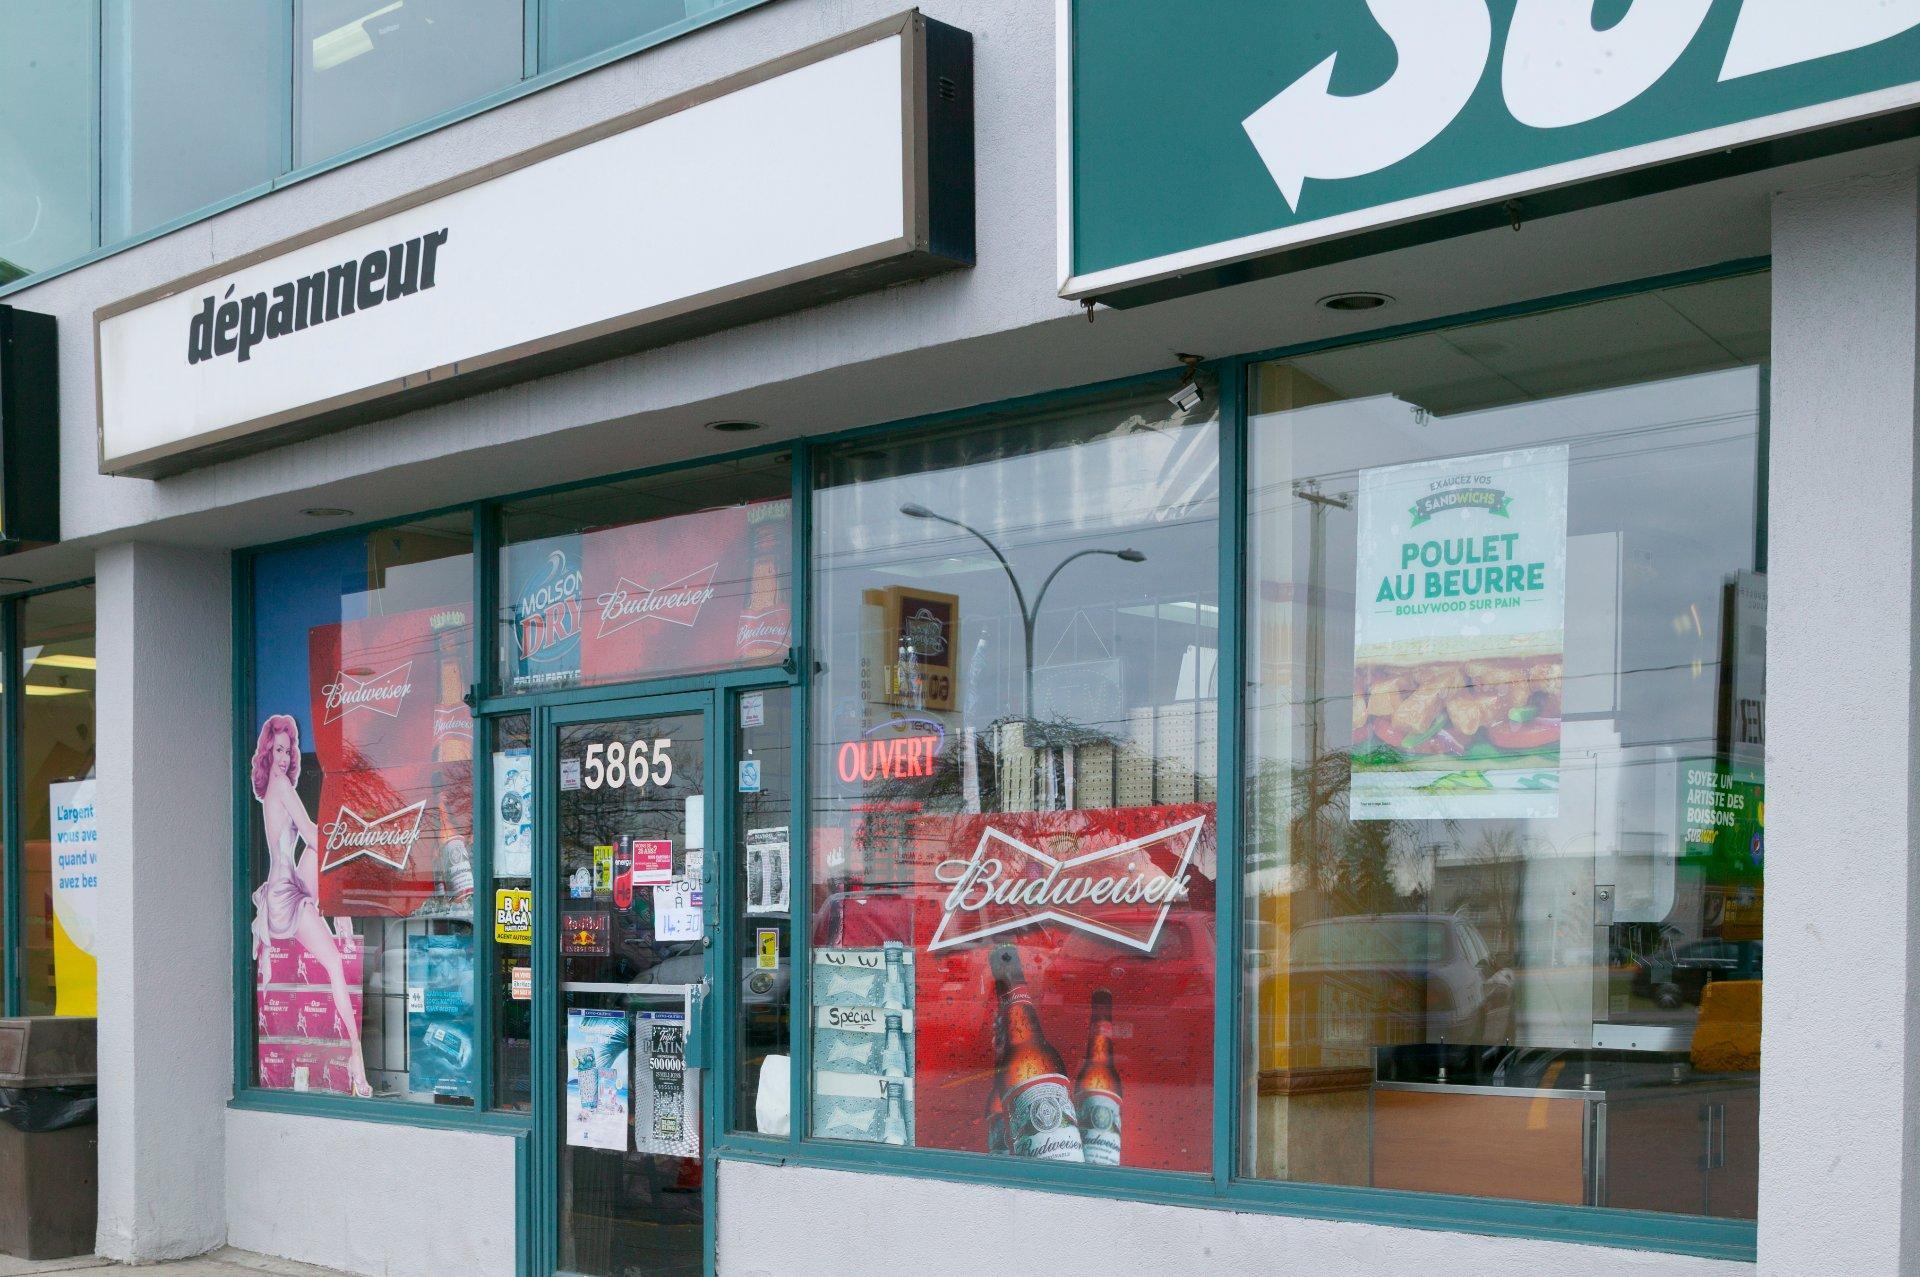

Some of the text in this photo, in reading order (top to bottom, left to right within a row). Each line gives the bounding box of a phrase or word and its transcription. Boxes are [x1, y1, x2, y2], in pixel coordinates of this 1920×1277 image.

[188, 228, 448, 364] dépanneur
[1430, 475, 1492, 491] EXAUCEZ VOS
[1424, 491, 1496, 512] SANDWICHS
[1401, 533, 1519, 570] POULET
[1375, 562, 1545, 603] AU BEURRE
[521, 571, 583, 616] MOLSON
[596, 585, 714, 620] Budweiser
[1396, 597, 1521, 616] BOLLYWOOD SUR PAIN
[738, 624, 792, 645] Budweis
[321, 680, 412, 709] Budweiser
[584, 738, 672, 790] 5865
[838, 735, 937, 783] OUVERT
[1687, 769, 1734, 790] SOYEZ UN
[1686, 789, 1745, 810] ARTISTE DES
[57, 804, 94, 823] L'argent
[1687, 807, 1735, 827] BOISSONS
[57, 829, 97, 844] vous ave
[323, 821, 420, 851] Budweiser
[1684, 828, 1719, 844] SUBWAY
[58, 850, 87, 869] quand
[59, 877, 80, 889] avez
[934, 859, 1189, 912] Budweiser
[829, 1006, 876, 1028] Spécial
[643, 1040, 684, 1054] PLATIN
